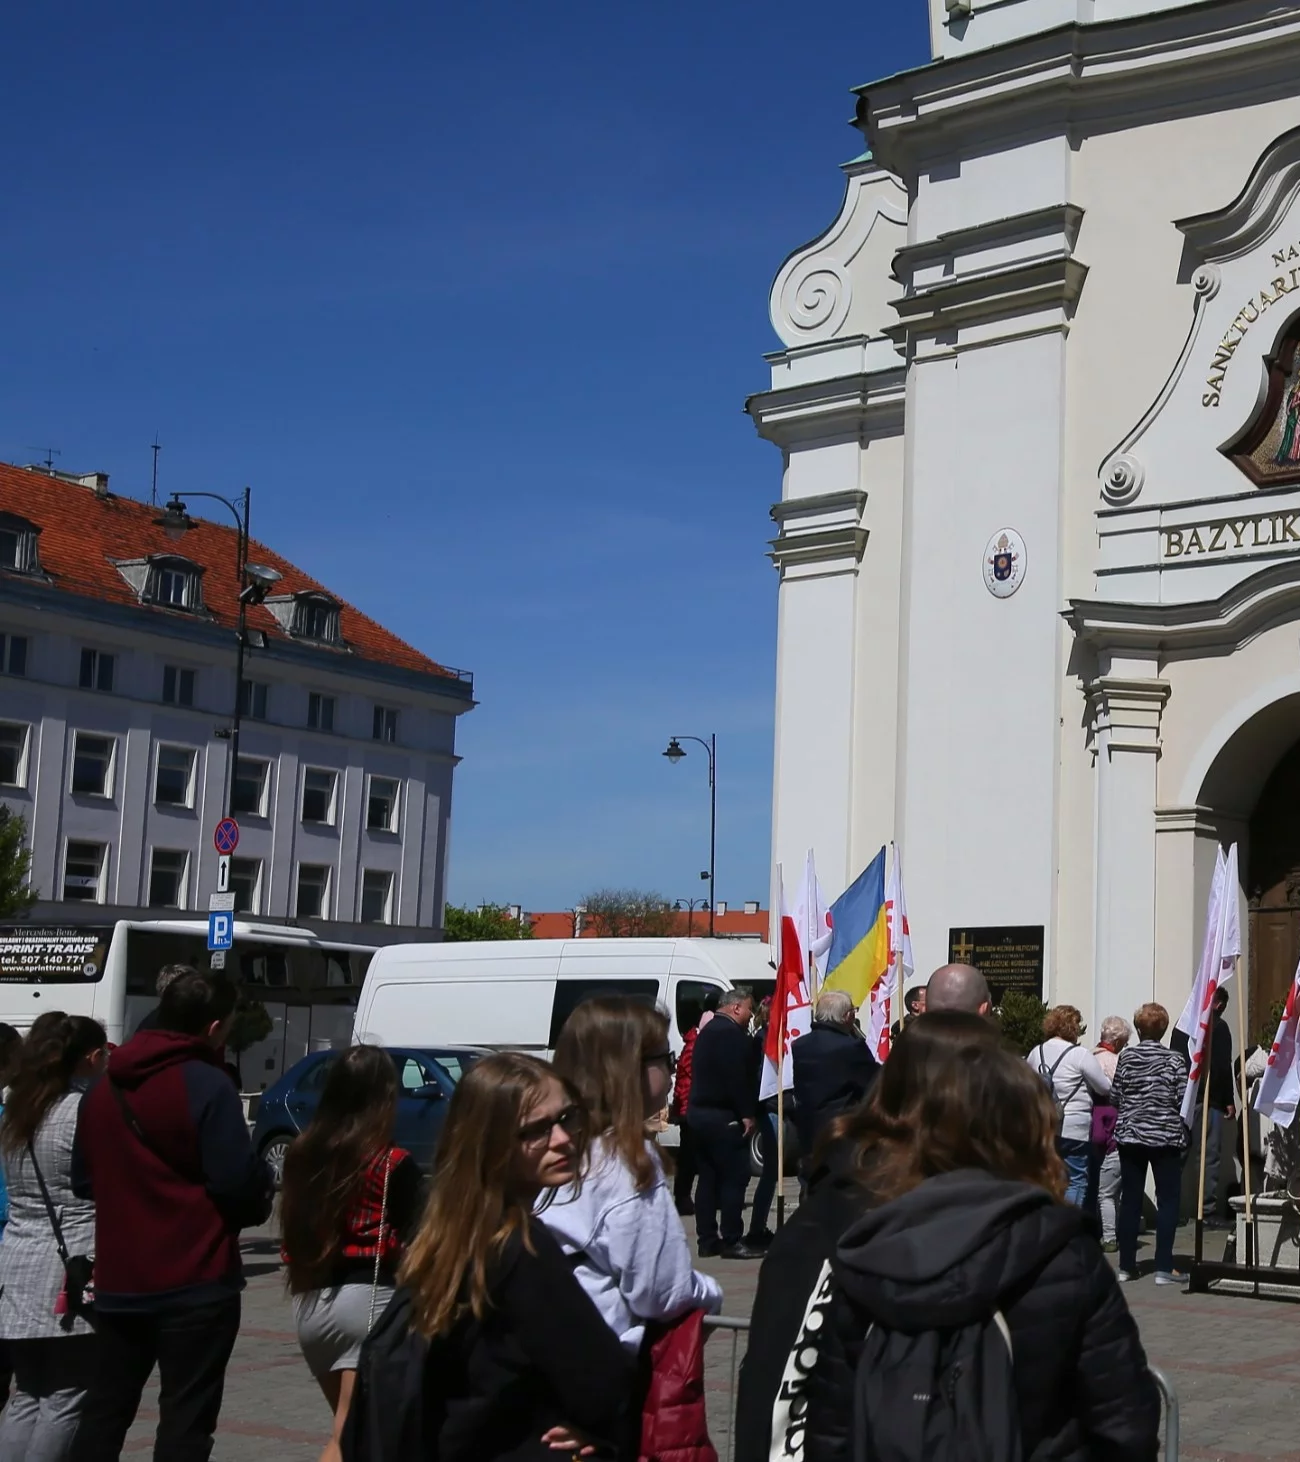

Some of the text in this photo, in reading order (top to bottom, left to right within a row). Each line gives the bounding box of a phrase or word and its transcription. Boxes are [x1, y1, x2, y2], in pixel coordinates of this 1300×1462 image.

[13, 928, 78, 937] Mercedes-Benz
[213, 916, 228, 945] P
[1, 955, 85, 964] tel. 507 140 771
[1, 964, 82, 973] www.sprinttrans.pl
